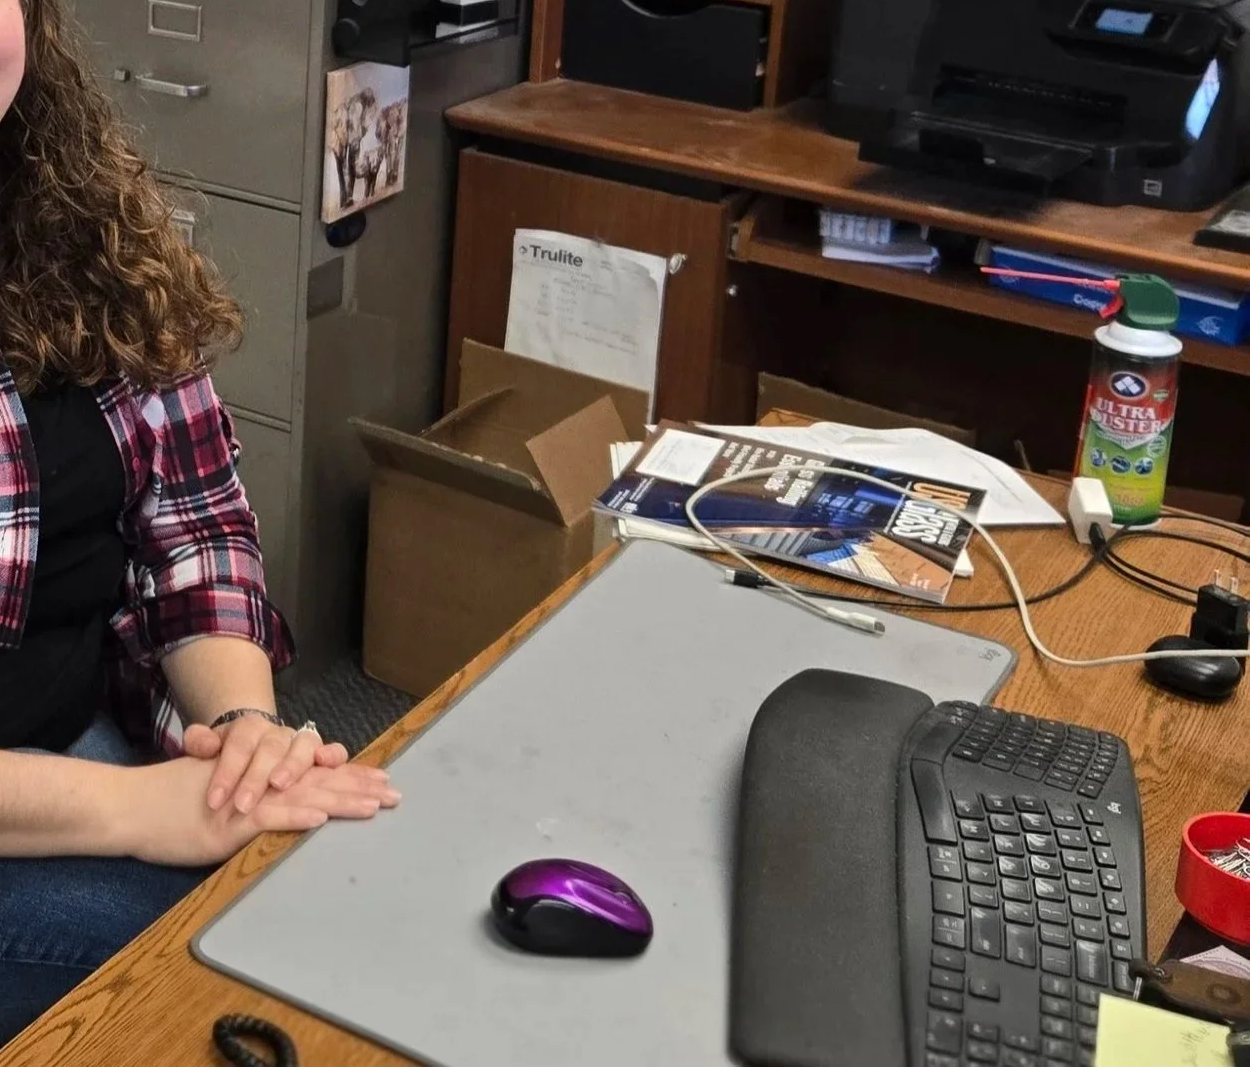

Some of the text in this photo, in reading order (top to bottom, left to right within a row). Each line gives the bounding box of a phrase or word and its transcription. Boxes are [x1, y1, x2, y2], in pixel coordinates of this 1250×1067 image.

[529, 245, 583, 267] Trulite
[1096, 397, 1157, 420] ULTRA
[1091, 409, 1165, 434] DUSTER
